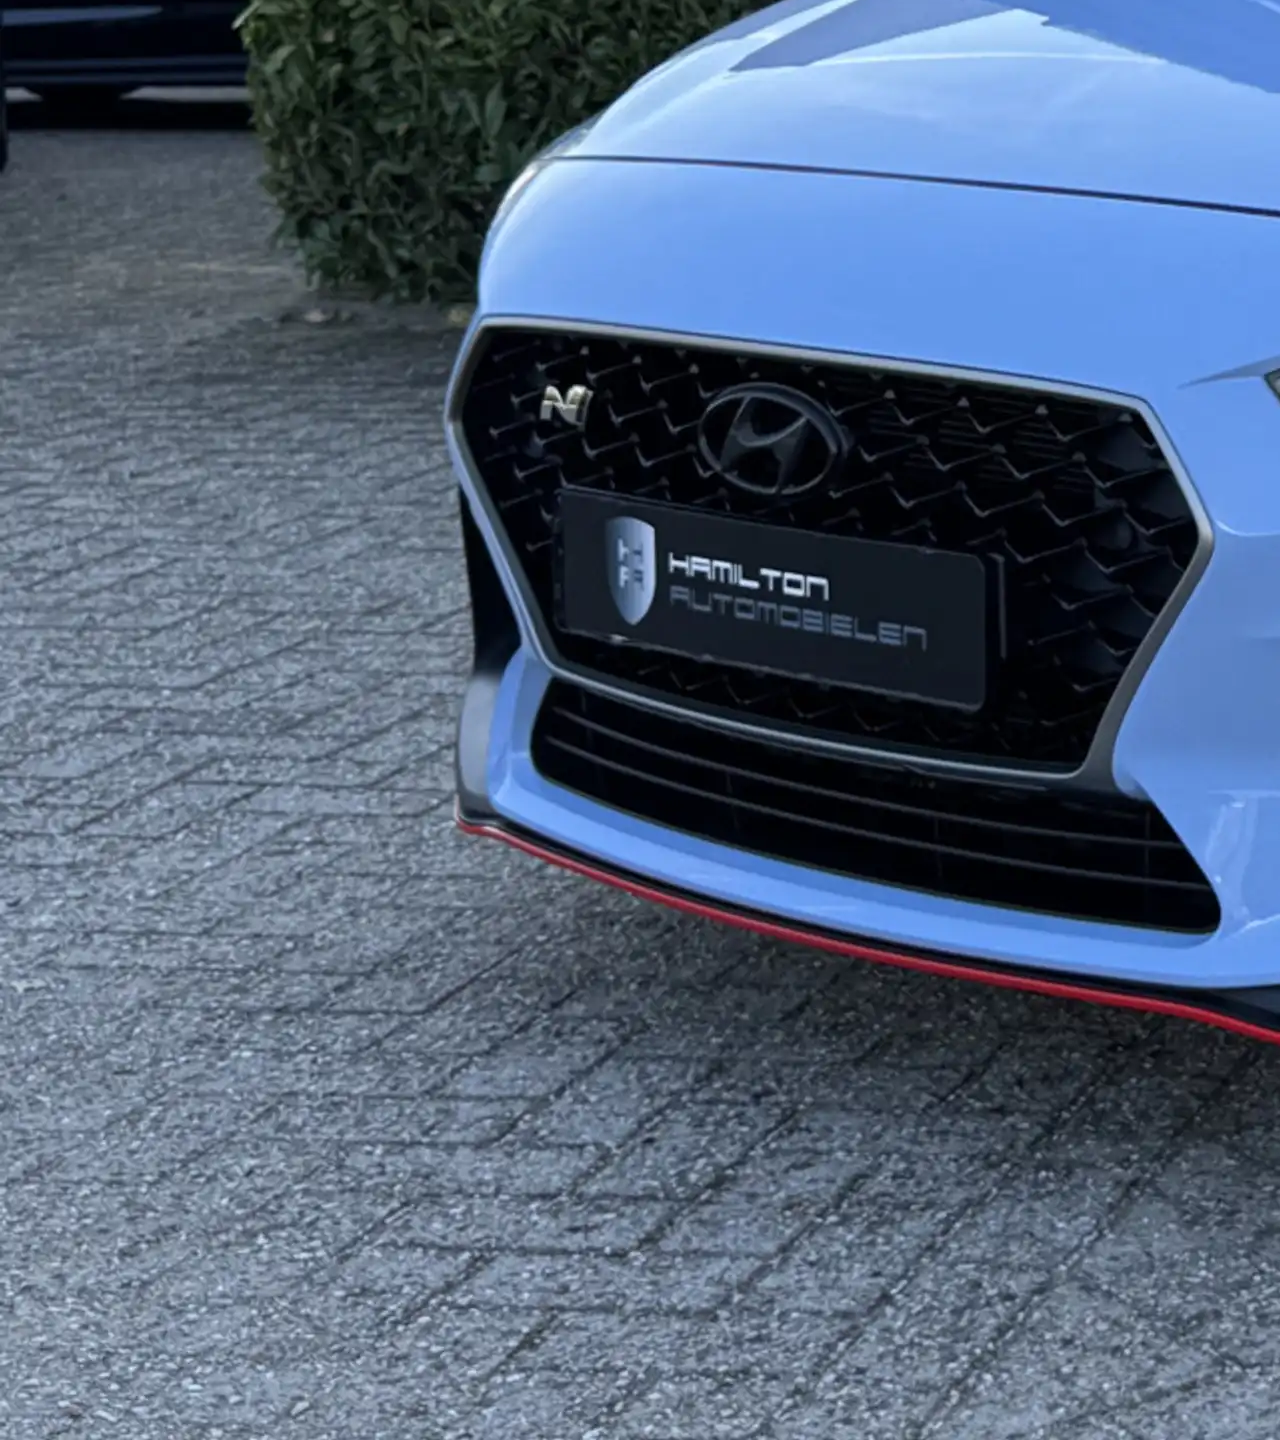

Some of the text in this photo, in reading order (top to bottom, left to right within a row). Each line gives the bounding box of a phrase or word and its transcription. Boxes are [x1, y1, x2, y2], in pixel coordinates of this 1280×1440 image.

[540, 384, 594, 431] N
[668, 552, 829, 602] HAMILTON
[669, 585, 928, 652] AUTOMOBIELEN
